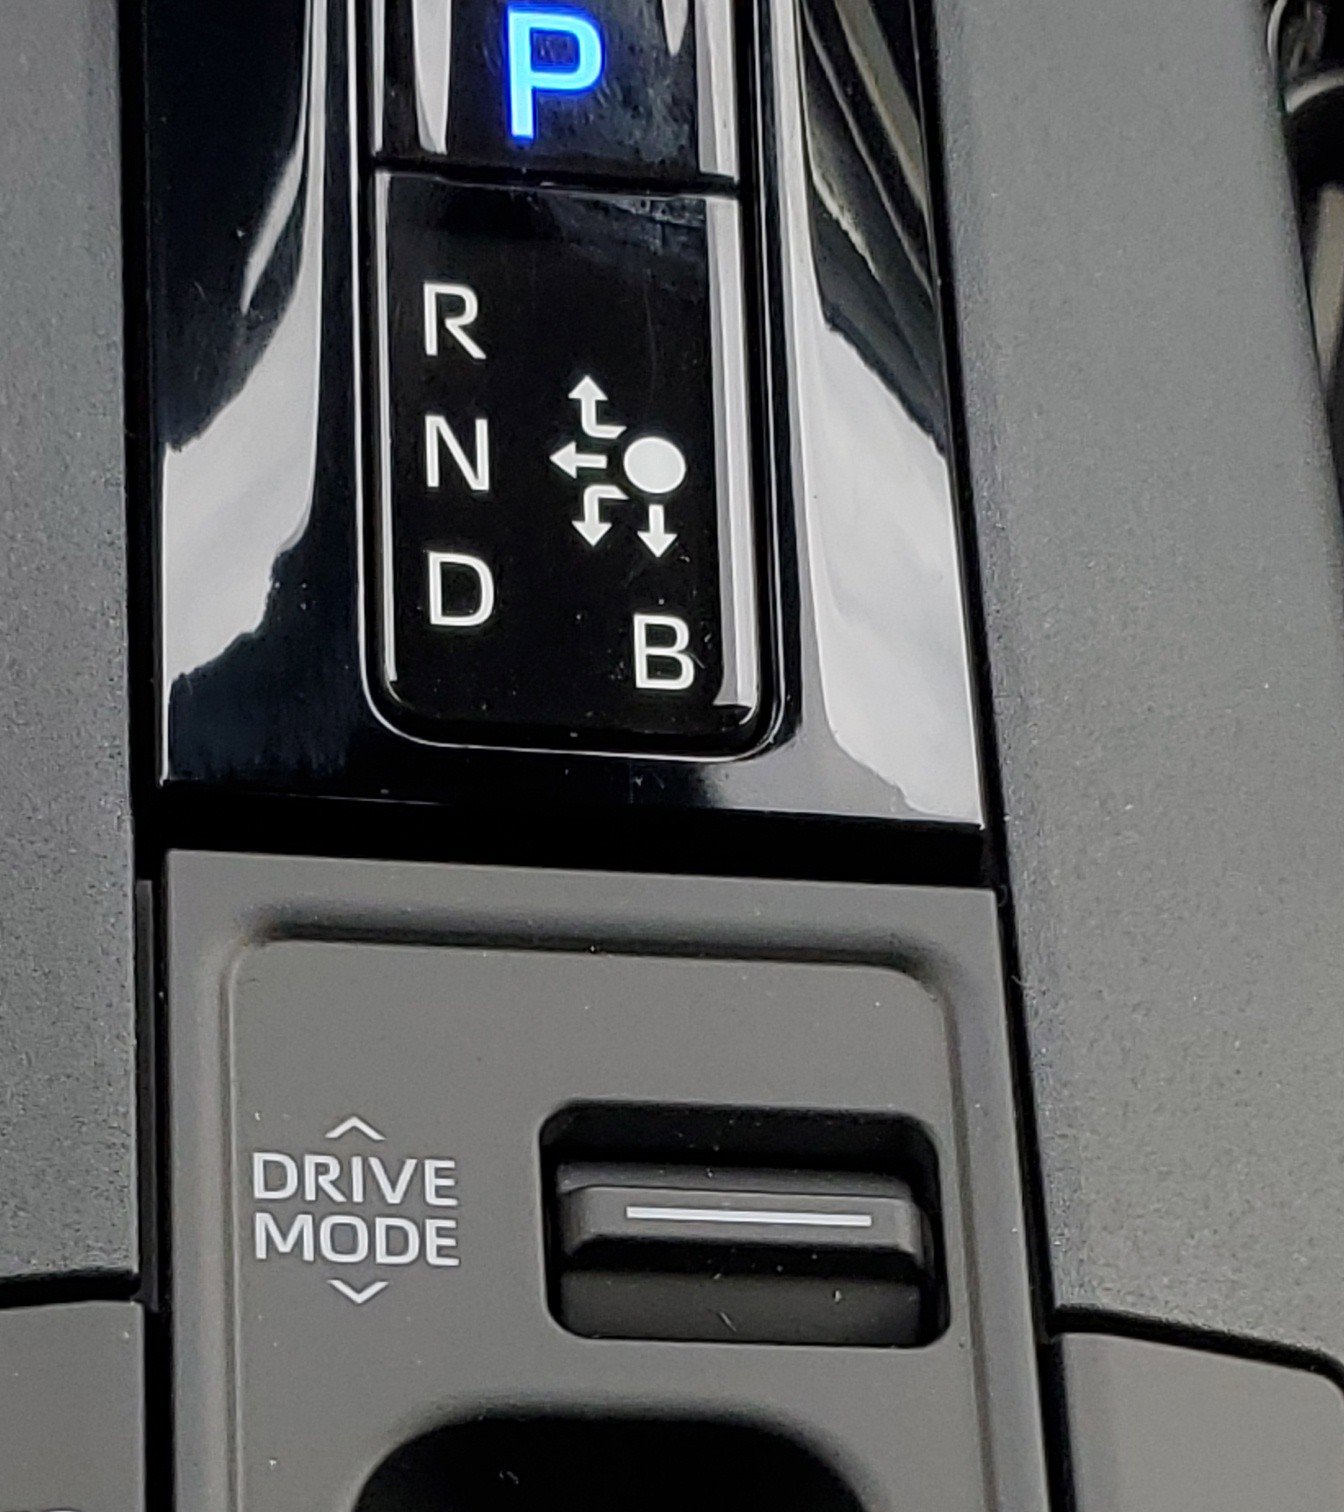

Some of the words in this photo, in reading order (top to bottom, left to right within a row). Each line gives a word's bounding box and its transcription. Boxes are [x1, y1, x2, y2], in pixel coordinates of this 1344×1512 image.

[506, 5, 604, 141] P
[423, 282, 487, 360] R
[425, 414, 490, 491] N
[427, 551, 494, 627] D
[632, 613, 696, 690] B
[253, 1151, 459, 1207] DRIVE
[254, 1211, 461, 1267] MODE
